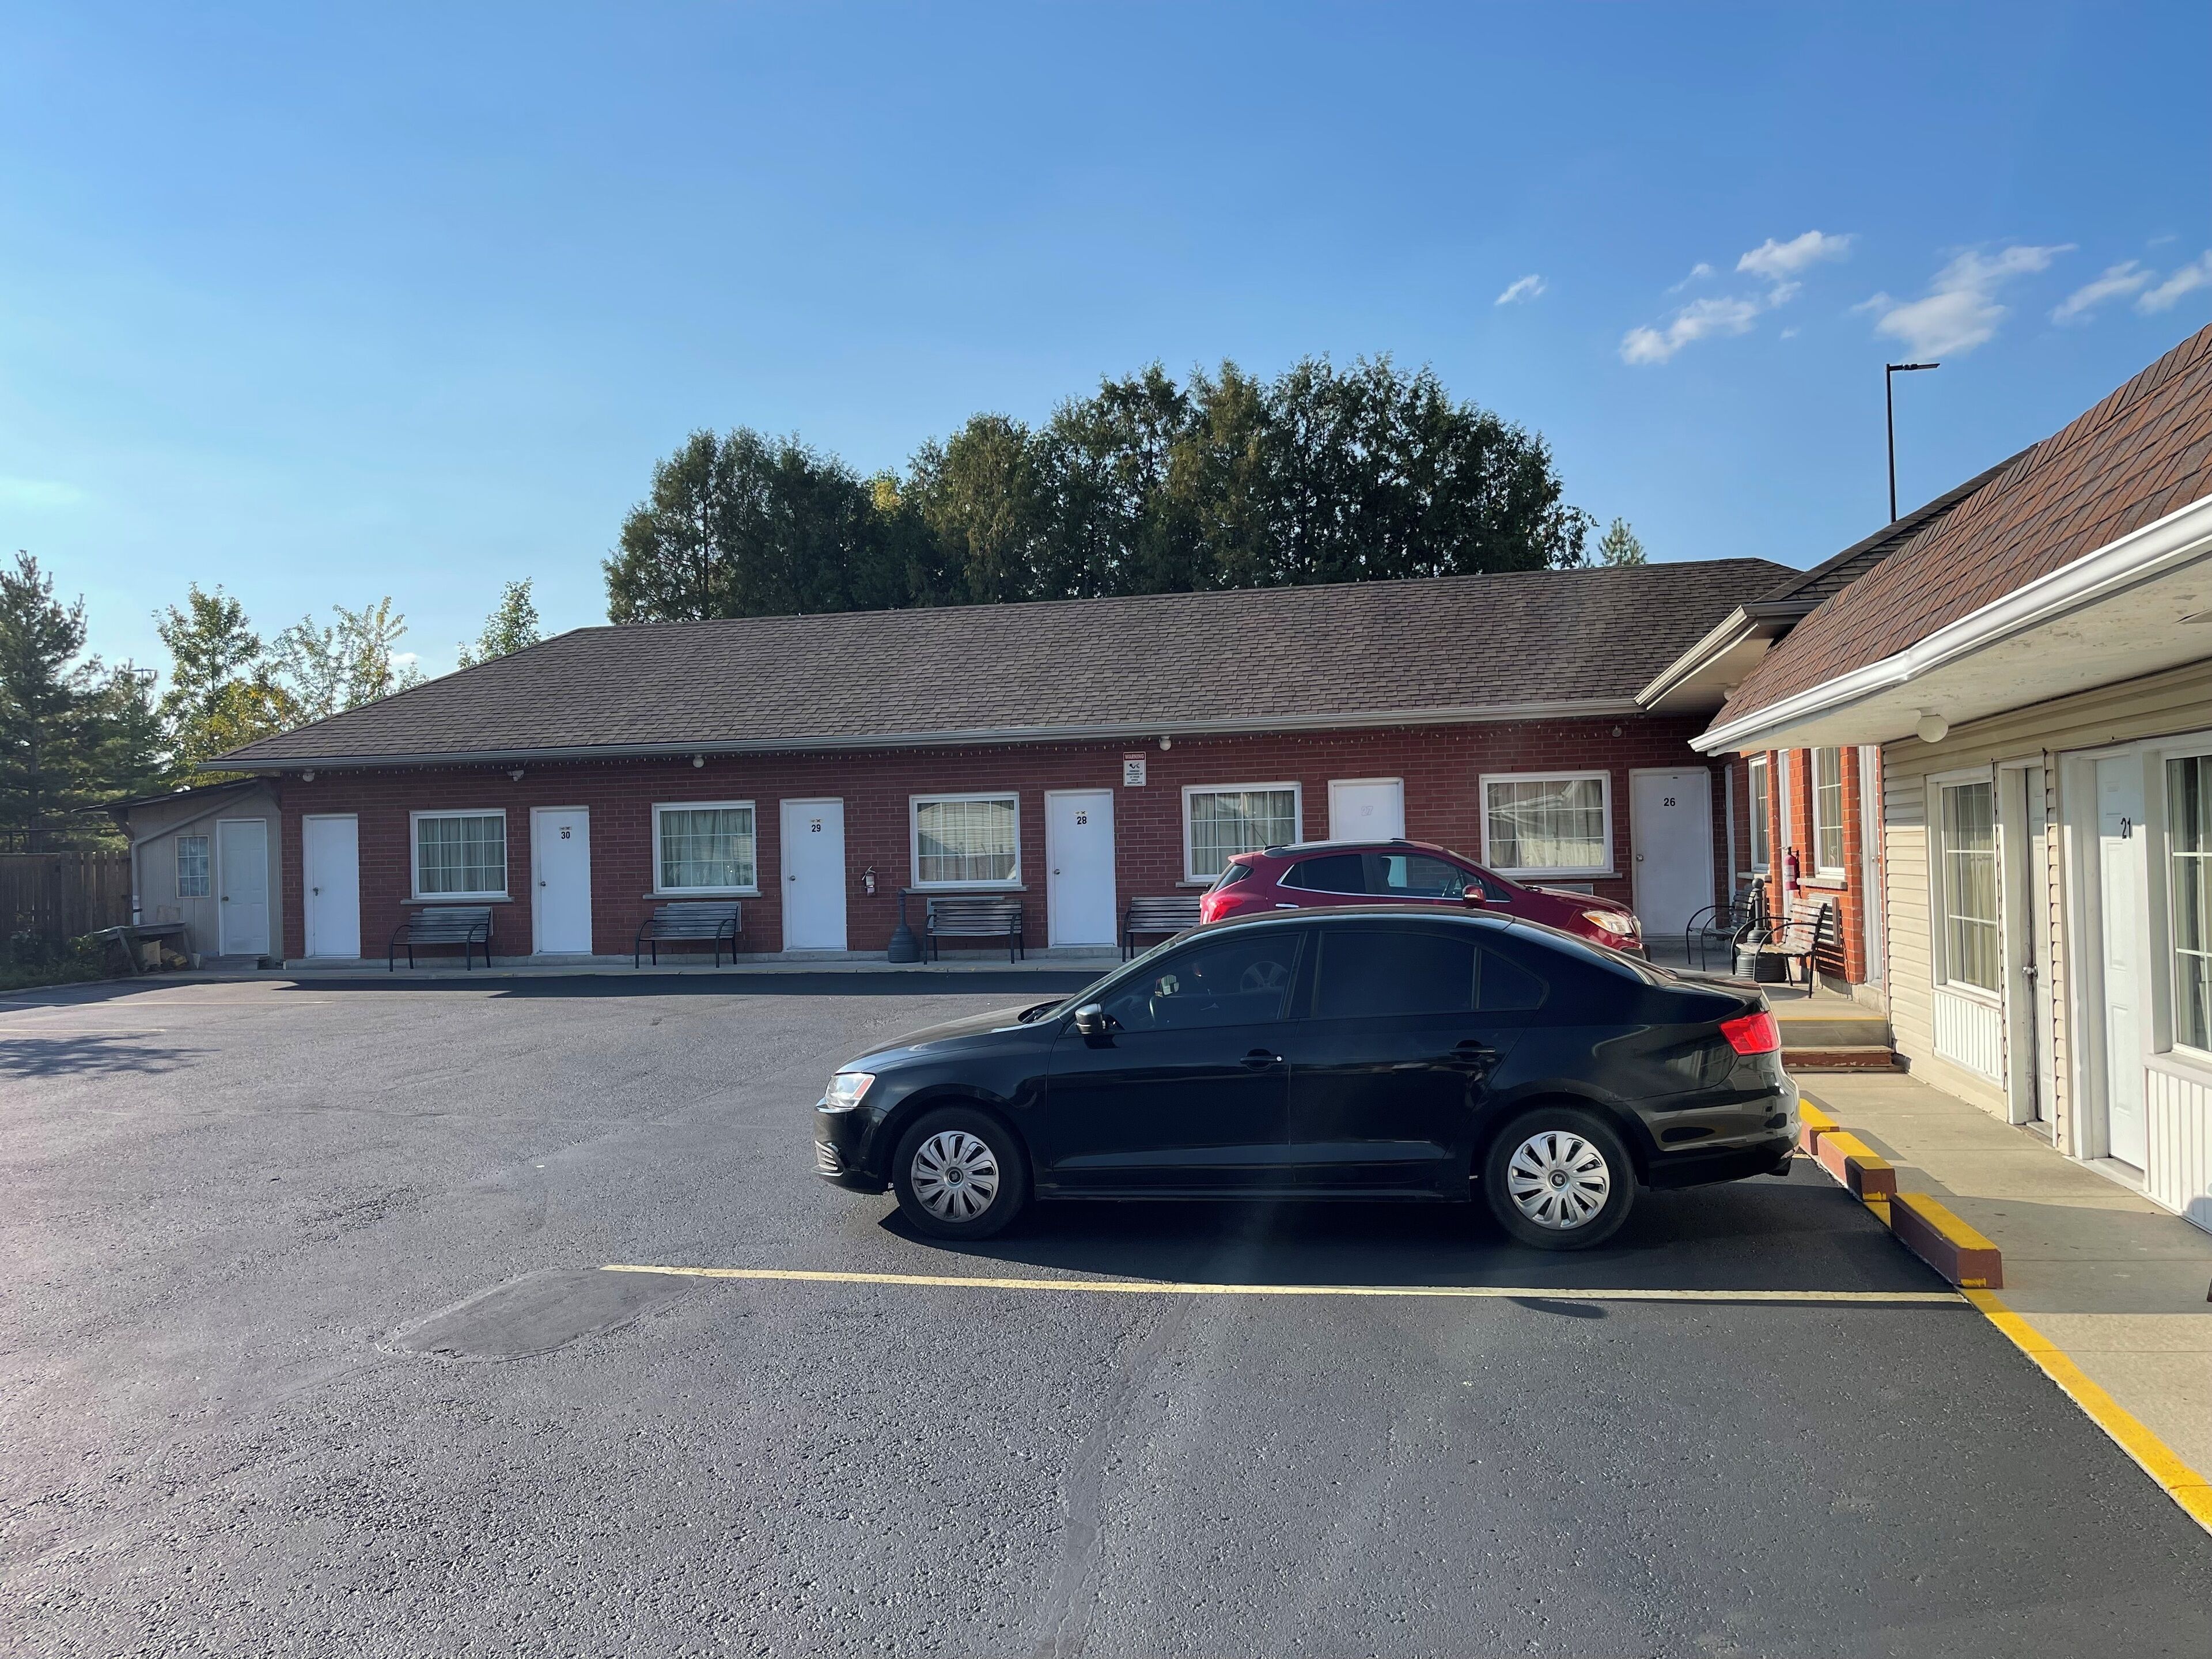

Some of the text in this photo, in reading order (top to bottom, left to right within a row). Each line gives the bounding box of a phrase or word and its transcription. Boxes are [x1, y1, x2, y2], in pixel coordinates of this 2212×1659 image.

[1664, 797, 1676, 806] 26
[1077, 816, 1087, 825] 28
[811, 824, 821, 832] 29
[2120, 817, 2131, 839] 21
[561, 831, 570, 839] 30
